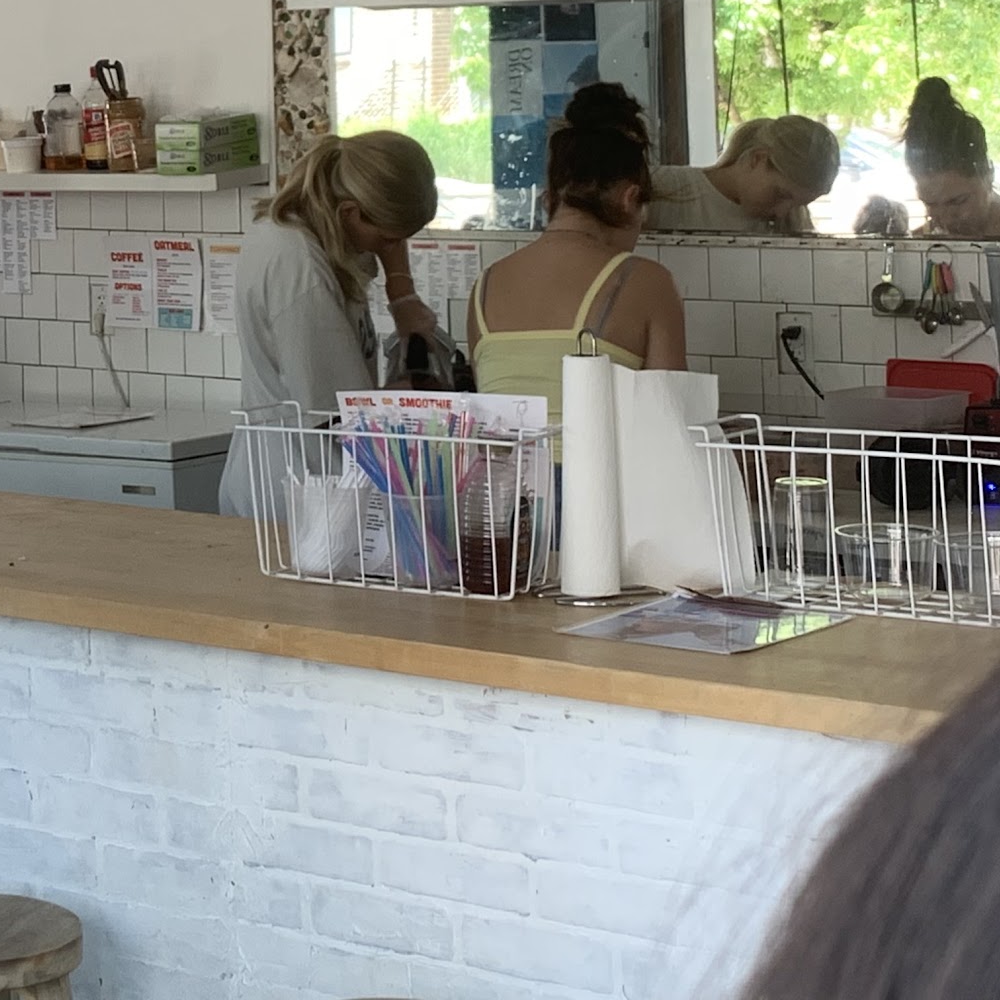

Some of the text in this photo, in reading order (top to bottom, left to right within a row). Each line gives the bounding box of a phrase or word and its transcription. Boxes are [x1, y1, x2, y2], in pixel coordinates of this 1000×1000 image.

[154, 240, 195, 252] OATMEAL
[110, 252, 144, 263] COFFEE
[114, 282, 143, 292] OPTIONS
[399, 397, 453, 409] SMOOTHIE
